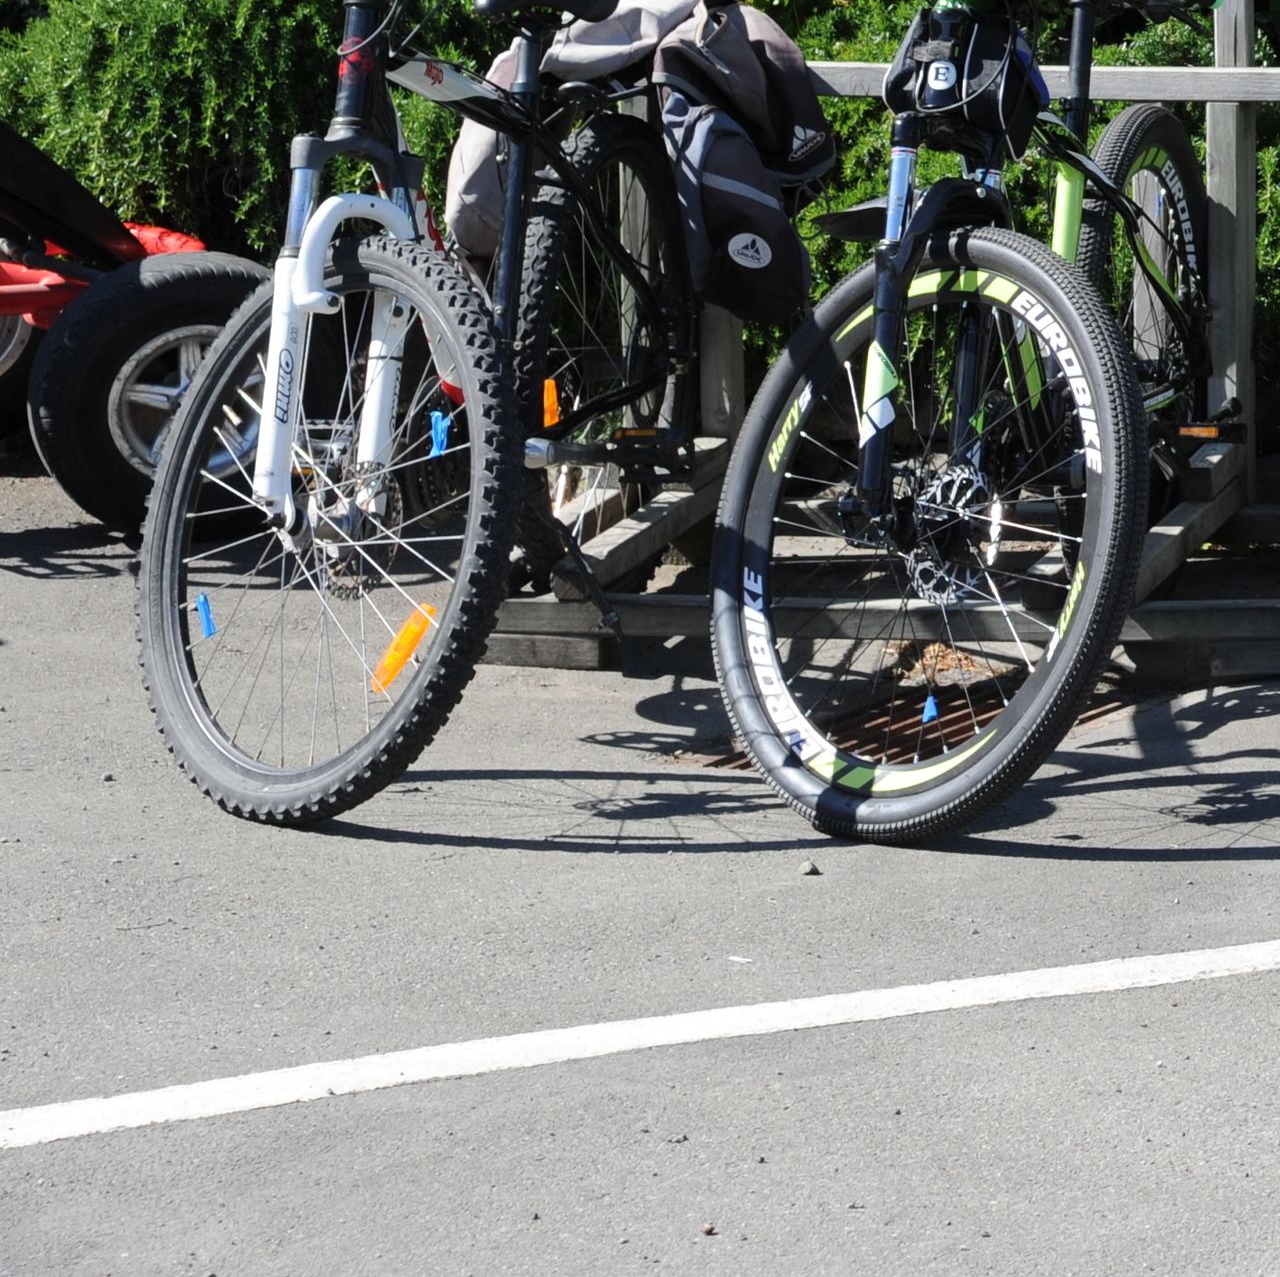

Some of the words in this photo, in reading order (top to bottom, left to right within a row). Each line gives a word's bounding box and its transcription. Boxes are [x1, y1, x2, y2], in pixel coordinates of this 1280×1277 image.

[933, 66, 949, 82] E
[1010, 290, 1103, 474] EUROBIKE
[768, 398, 800, 473] Harry
